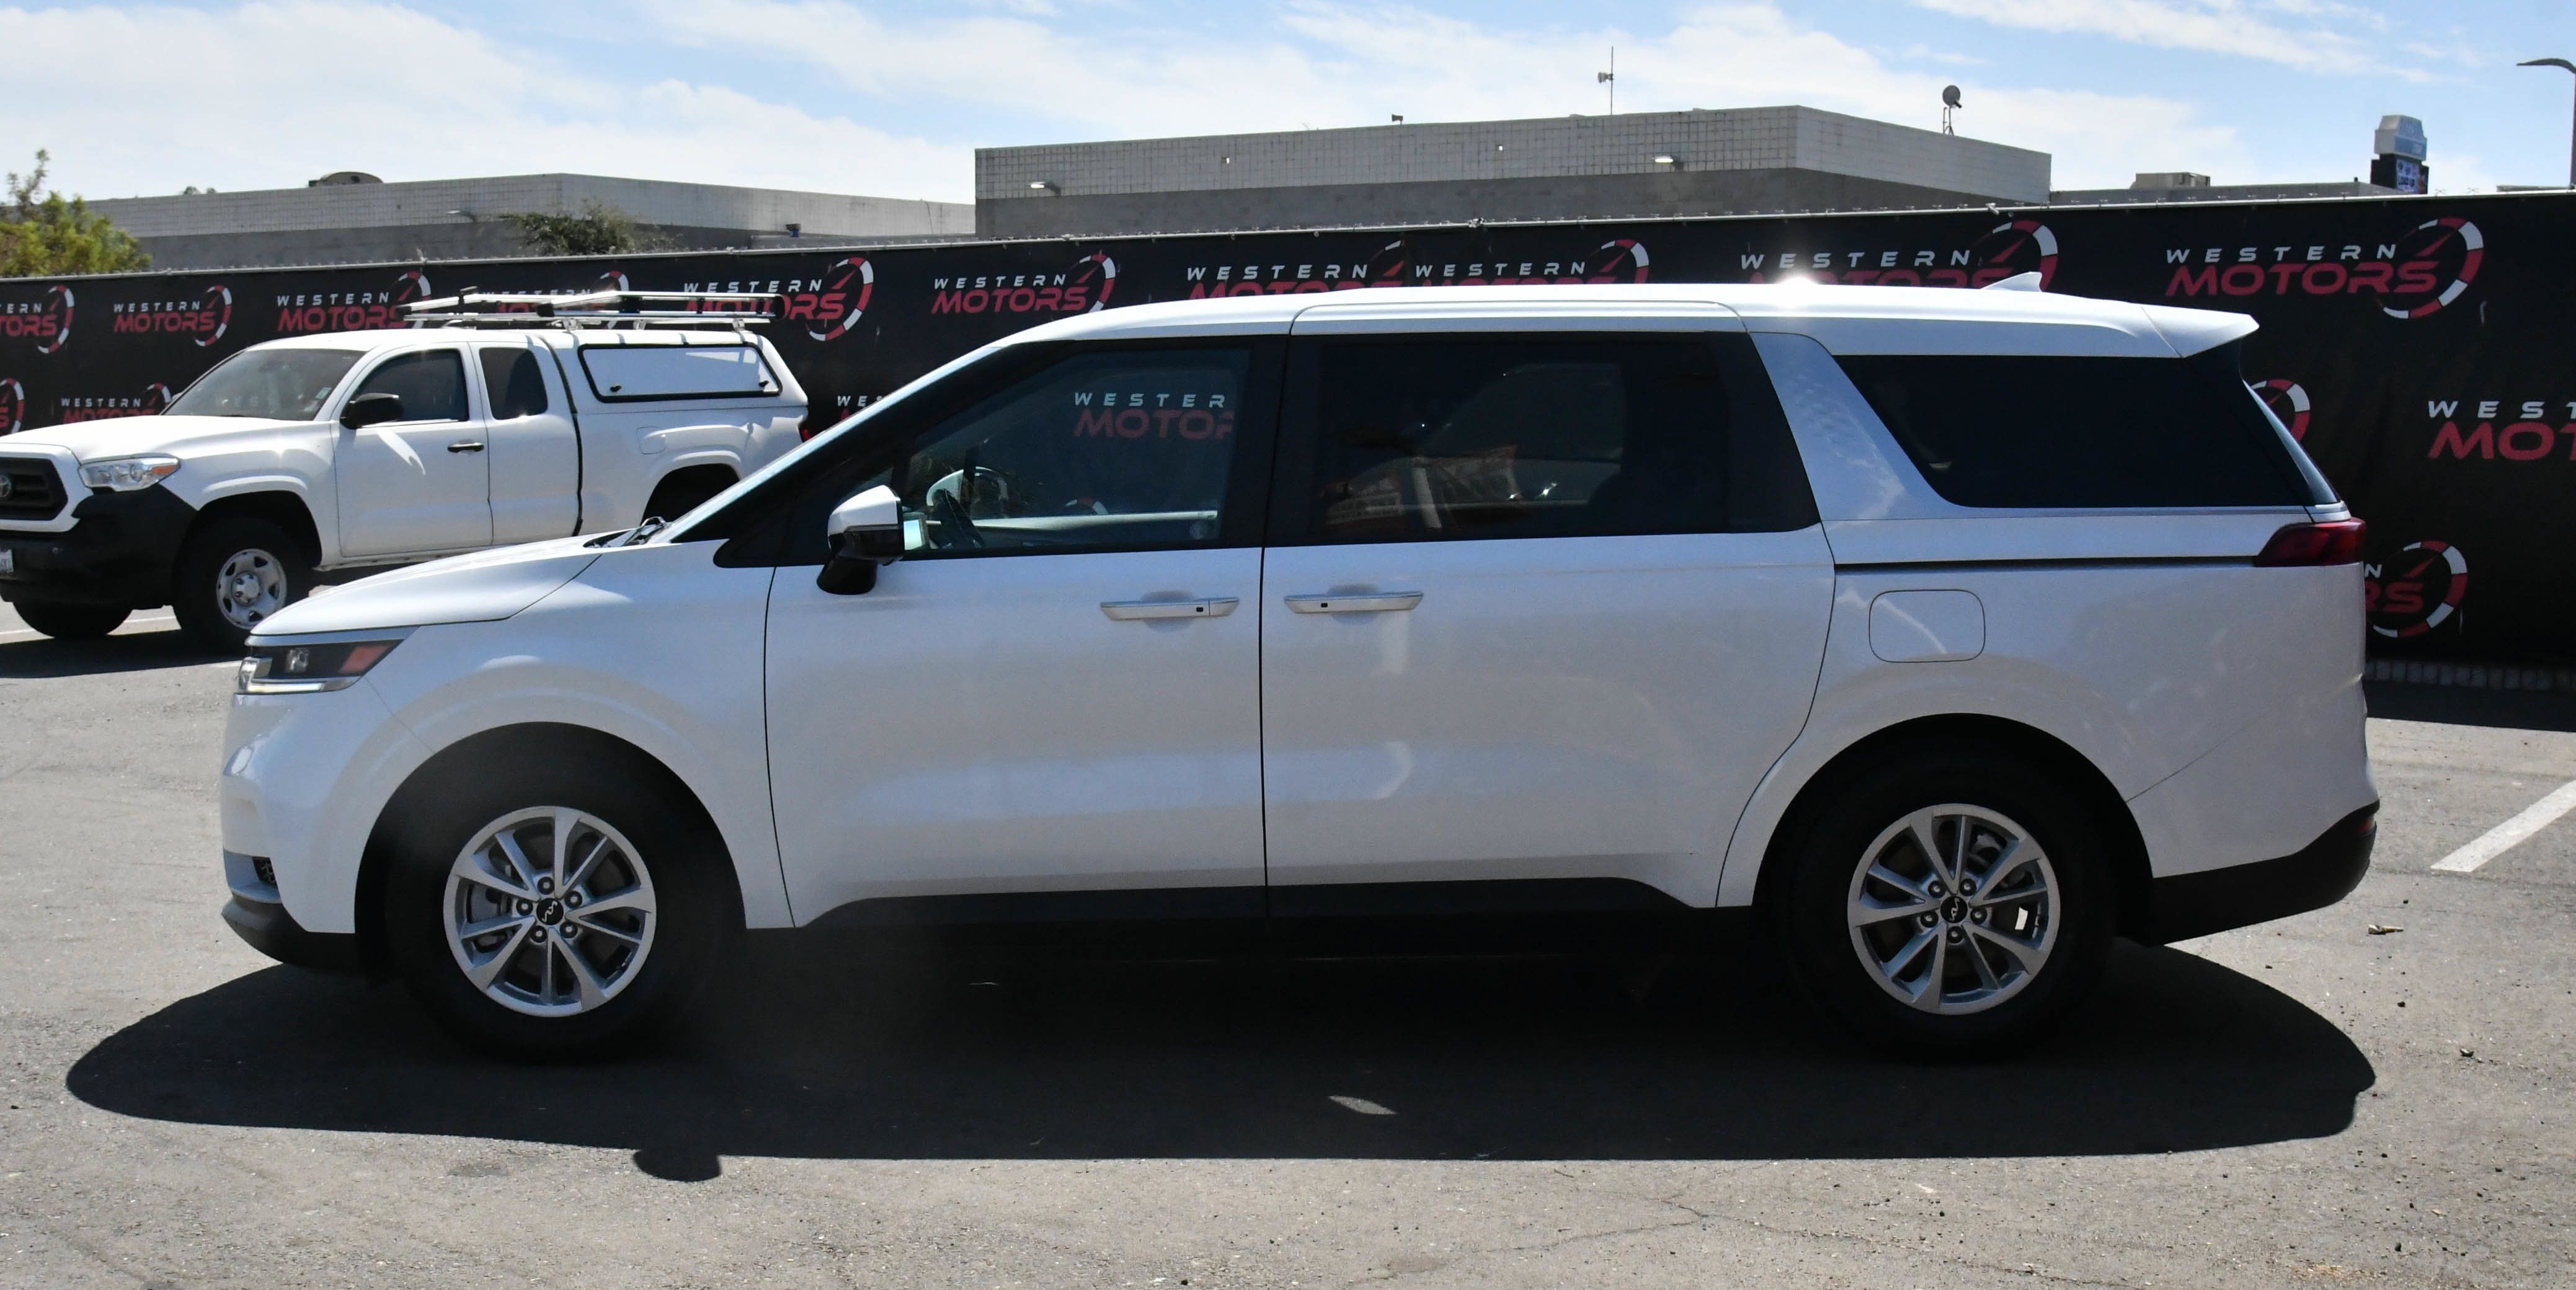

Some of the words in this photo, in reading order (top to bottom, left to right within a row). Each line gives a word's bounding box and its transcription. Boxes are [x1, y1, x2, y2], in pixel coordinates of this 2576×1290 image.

[1741, 250, 1970, 268] WESTERN
[2167, 244, 2397, 263] WESTERN
[1187, 264, 1368, 281] WESTERN
[1416, 262, 1586, 278] WESTERN
[2165, 260, 2440, 296] MOTORS
[683, 279, 823, 293] WESTERN
[934, 274, 1067, 289] WESTERN
[113, 301, 201, 312] WESTERN
[277, 292, 390, 307] WESTERN
[931, 286, 1090, 314] MOTORS
[113, 311, 215, 333] MOTORS
[277, 304, 407, 332] MOTORS
[61, 398, 141, 407] WESTERN
[1074, 392, 1226, 408] WESTER
